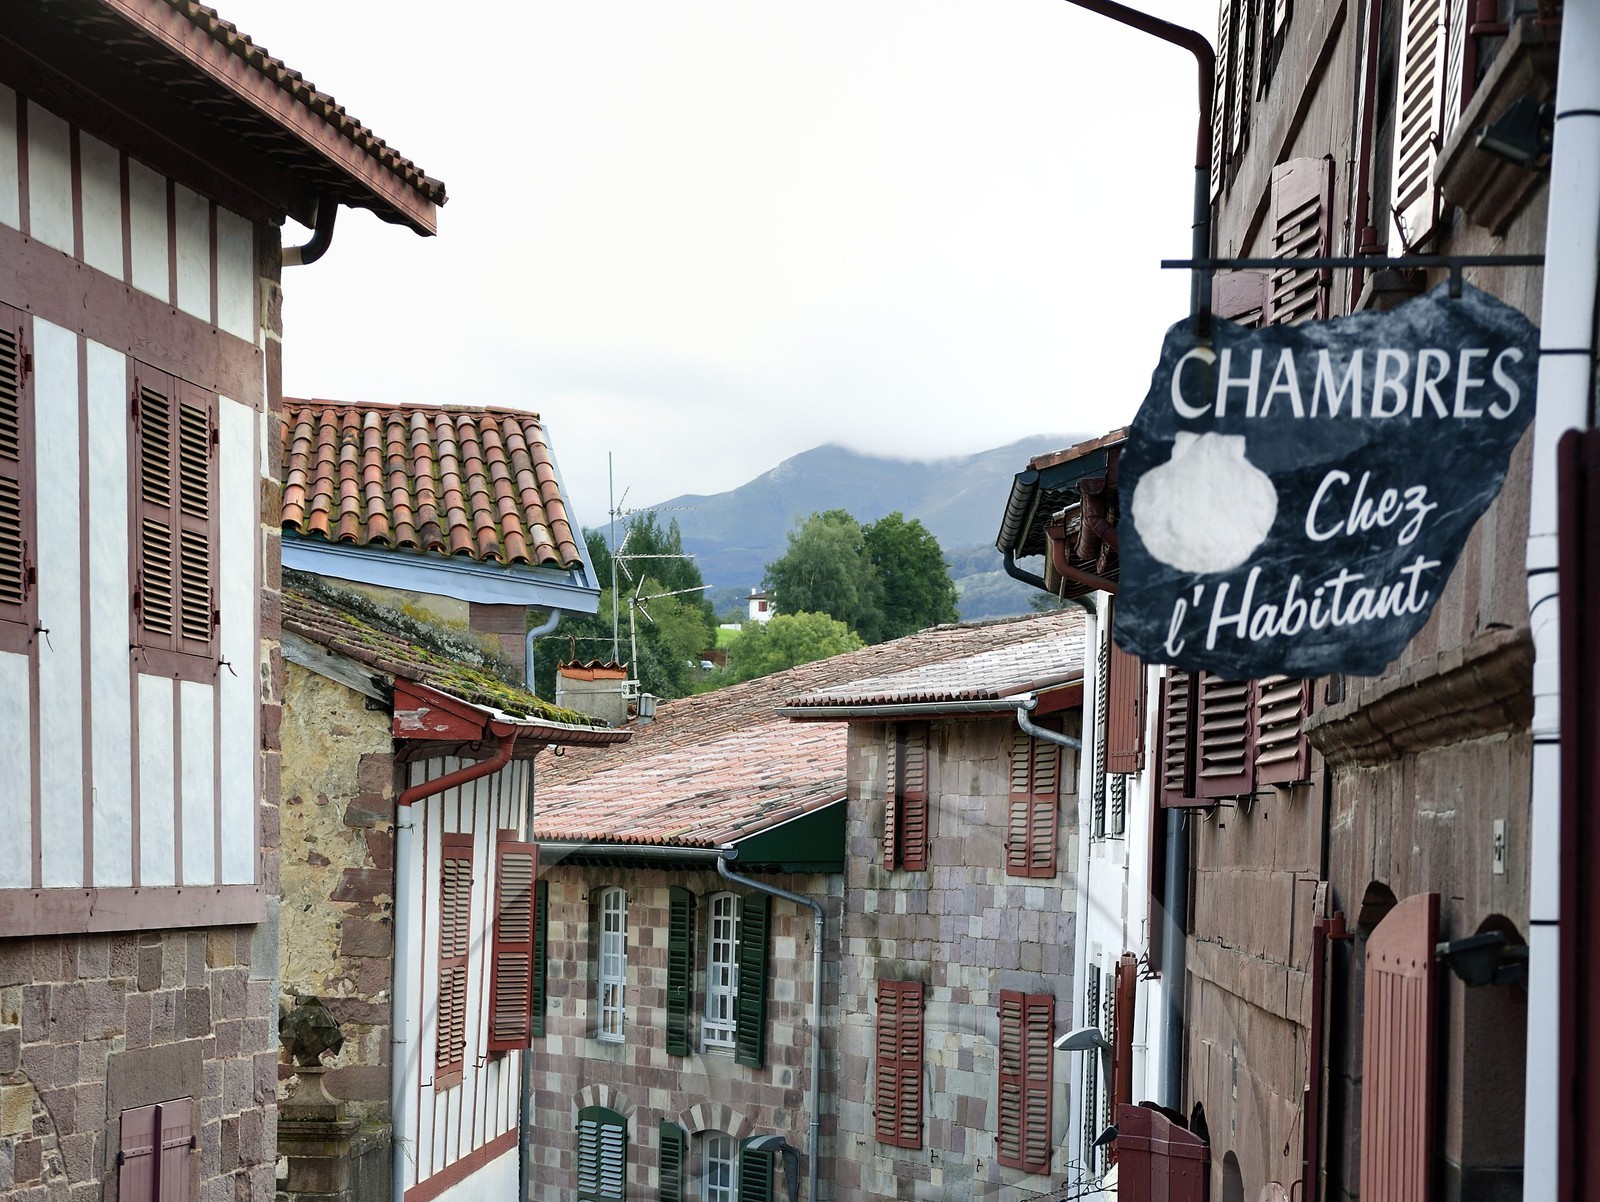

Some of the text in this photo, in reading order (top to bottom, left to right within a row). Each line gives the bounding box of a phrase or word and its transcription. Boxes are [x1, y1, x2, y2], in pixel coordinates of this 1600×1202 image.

[1170, 347, 1524, 420] CHAMBRES
[1305, 469, 1438, 546] Chez
[1163, 554, 1442, 658] l'Habitant
